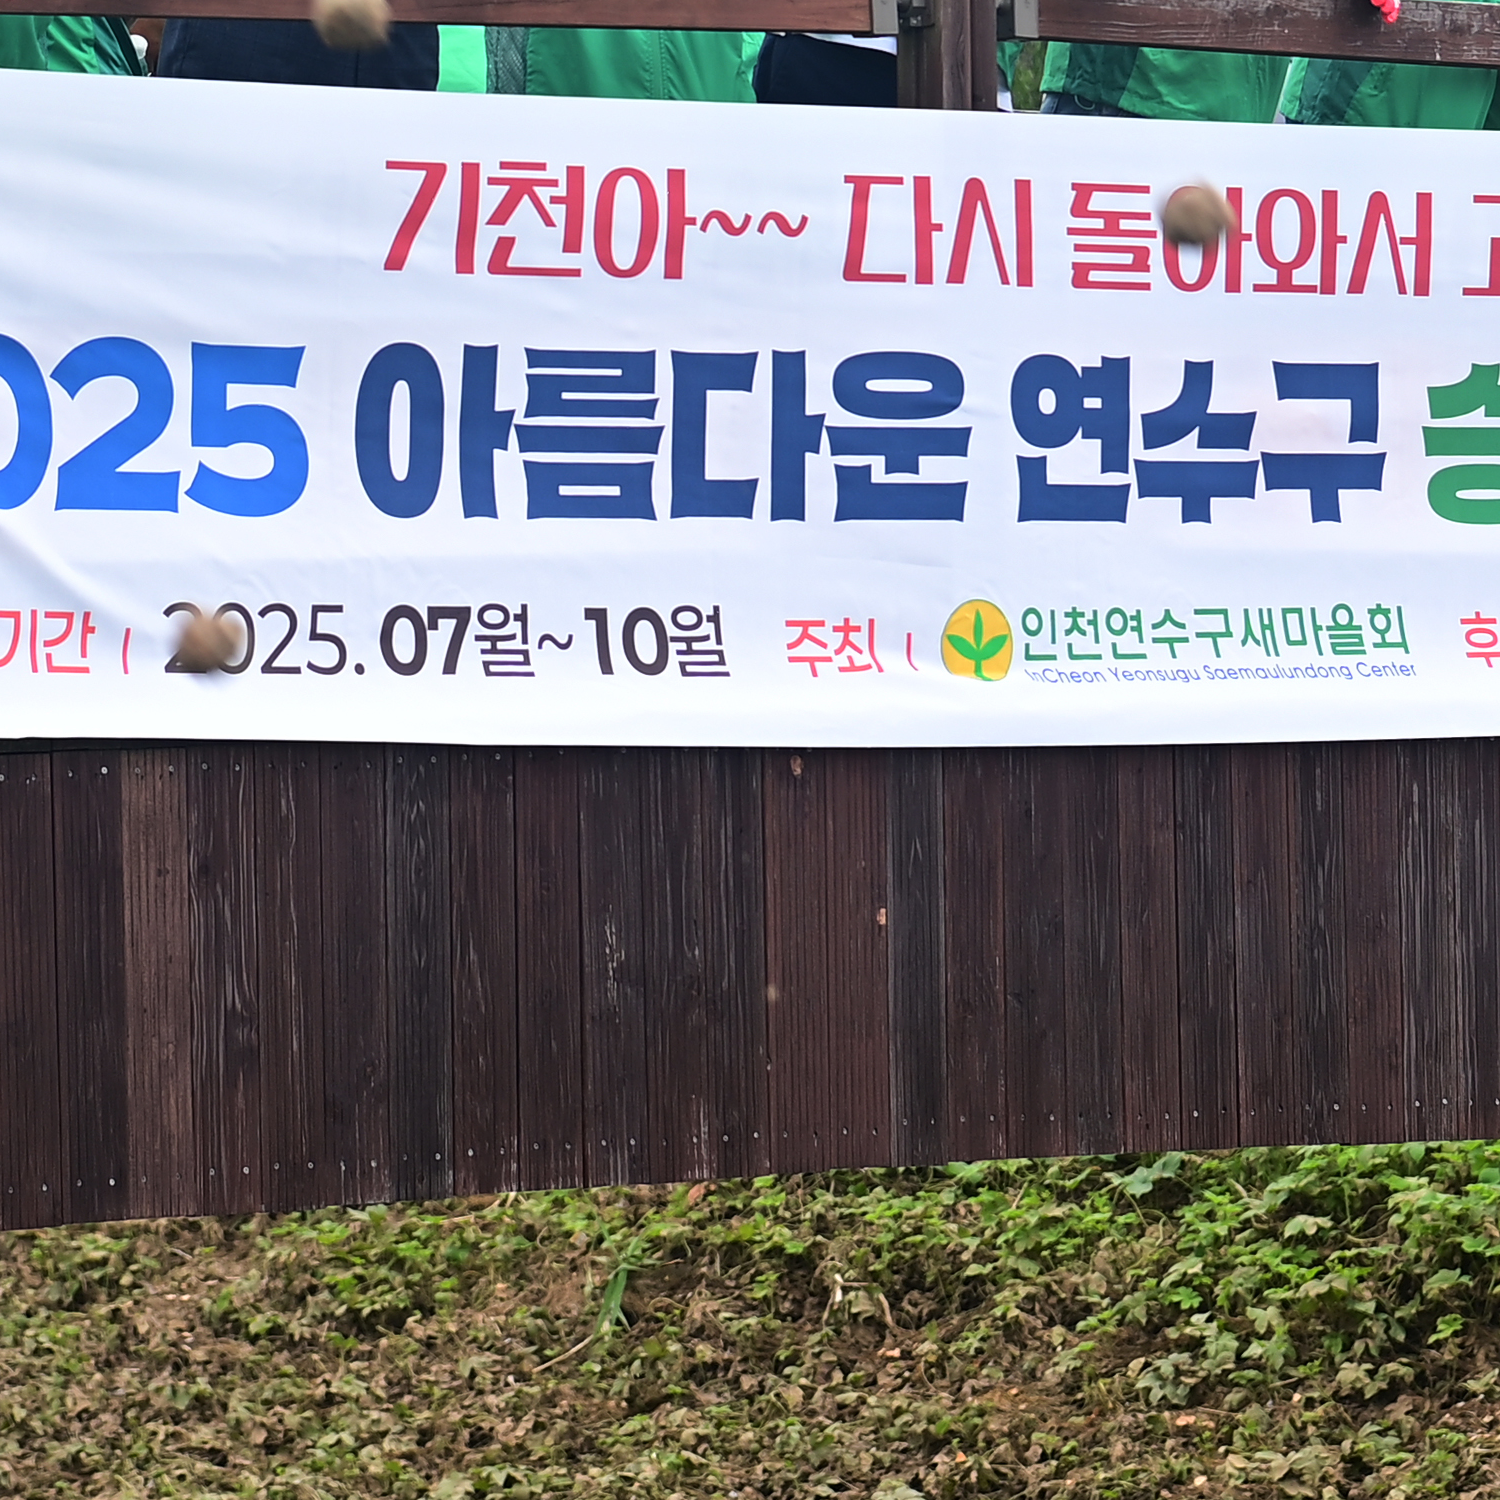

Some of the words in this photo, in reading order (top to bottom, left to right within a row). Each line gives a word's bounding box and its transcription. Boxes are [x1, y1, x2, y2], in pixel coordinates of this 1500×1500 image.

[384, 160, 809, 280] 기천아~~
[843, 175, 1034, 288] 다시
[1066, 182, 1433, 297] 돌아와서
[354, 342, 973, 522] 아름다운
[1010, 354, 1388, 524] 연수구
[785, 617, 886, 678] 주최
[1021, 603, 1411, 661] 인천연수구새마을회
[1107, 666, 1202, 683] Yeonsugu
[1202, 663, 1354, 681] Saemaulundong
[1355, 661, 1418, 678] Center
